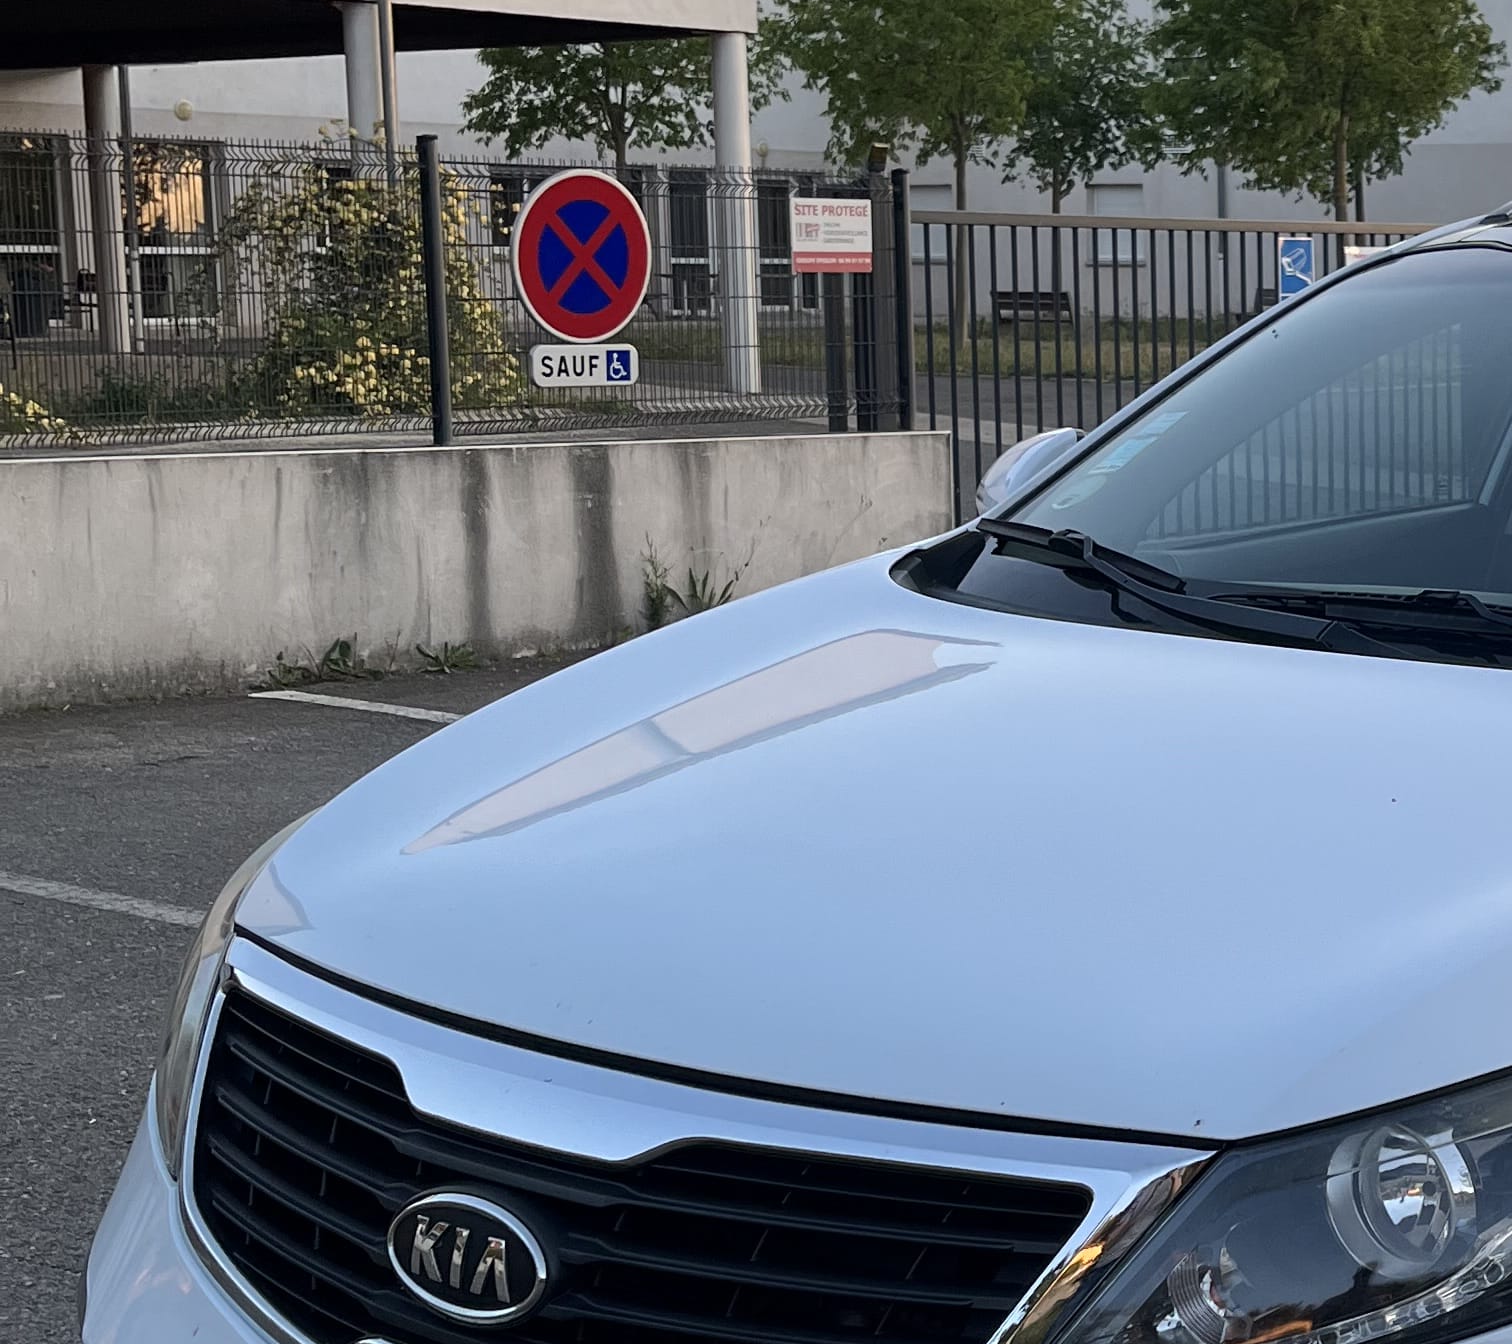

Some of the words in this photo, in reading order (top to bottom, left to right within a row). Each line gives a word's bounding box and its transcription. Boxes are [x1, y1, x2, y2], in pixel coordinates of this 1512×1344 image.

[794, 203, 818, 216] SITE
[541, 355, 600, 377] SAUF
[410, 1214, 511, 1304] KIA
